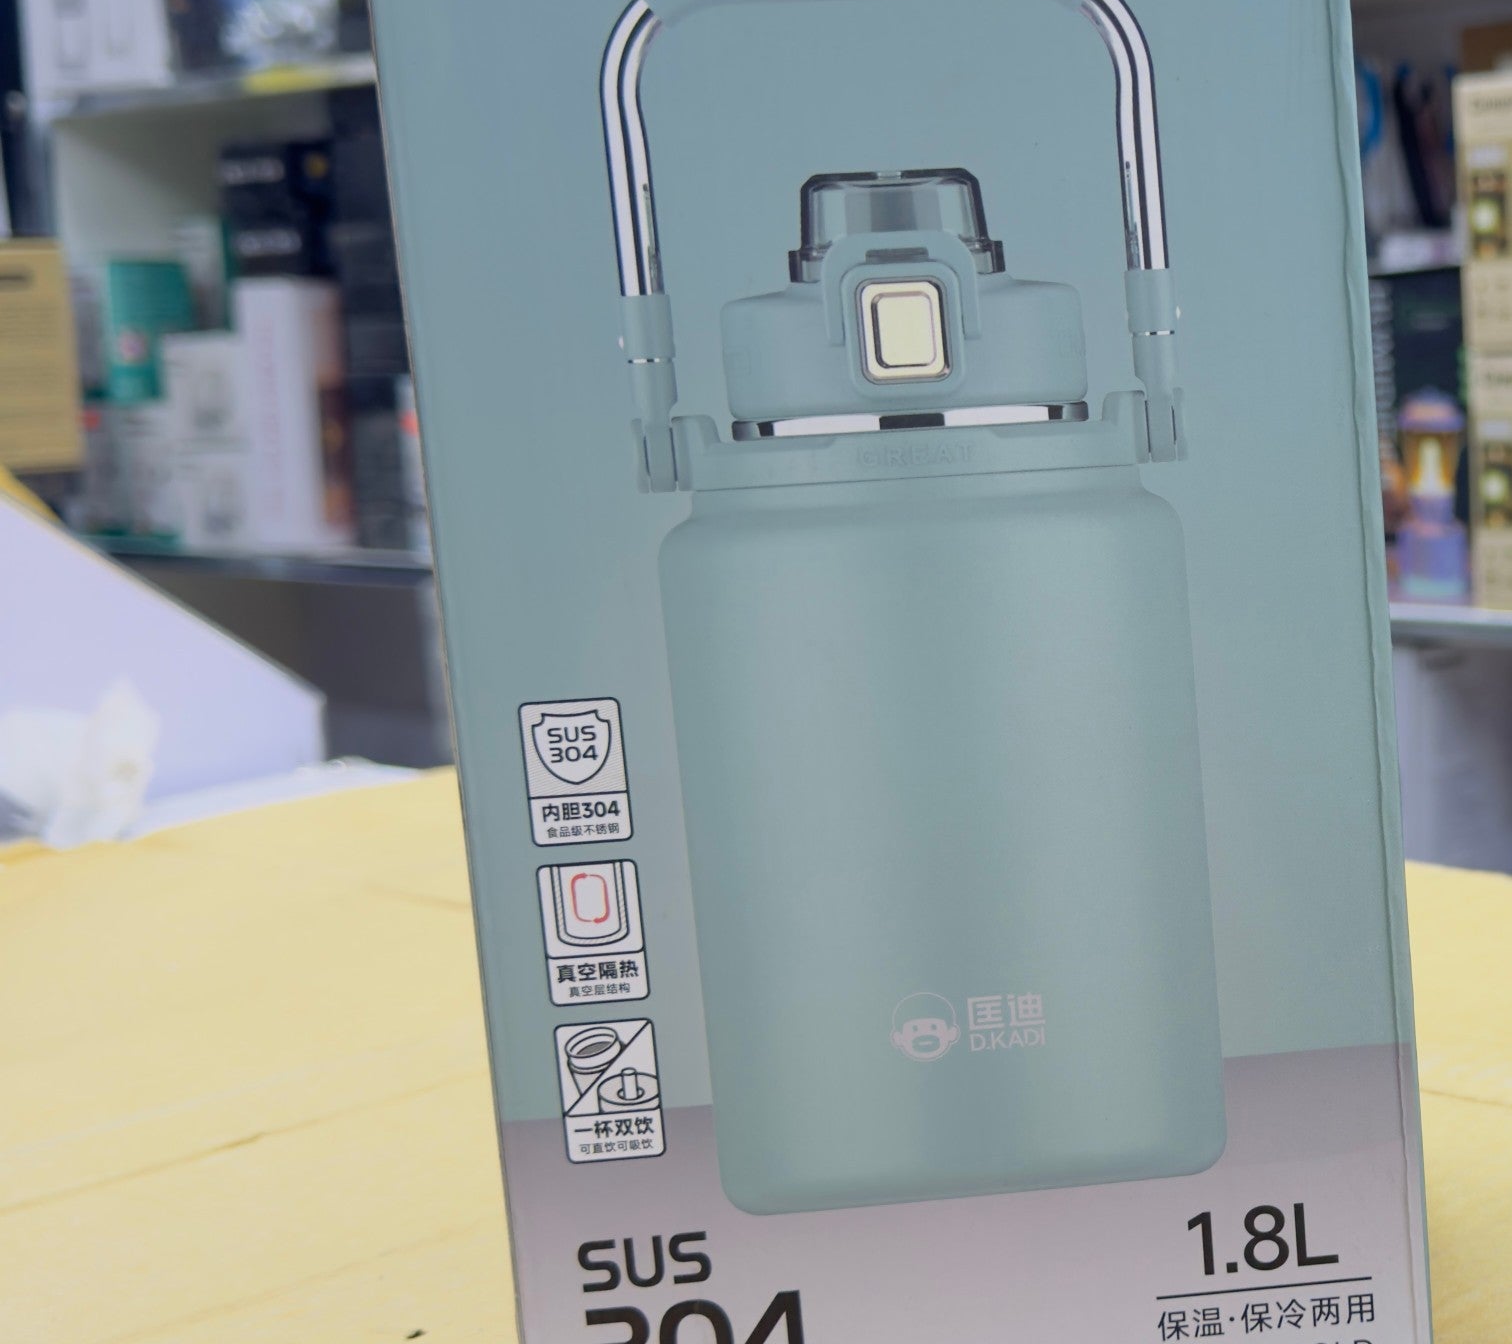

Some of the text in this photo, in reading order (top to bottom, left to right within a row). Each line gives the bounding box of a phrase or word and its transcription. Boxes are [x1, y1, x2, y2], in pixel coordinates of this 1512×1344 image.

[547, 725, 597, 744] SUS
[549, 744, 598, 763] 304
[542, 801, 620, 823] 内胆304
[547, 822, 620, 839] 食品级不锈钢
[556, 960, 639, 983] 真空隔热
[569, 982, 631, 998] 真空层结构
[966, 992, 1046, 1031] 匡迪
[574, 1117, 655, 1139] 一杯双饮
[579, 1138, 654, 1155] 可直饮可吸饮
[1187, 1202, 1340, 1276] 1.8L
[577, 1230, 712, 1293] SUS
[1157, 1293, 1376, 1342] 保温·保冷两用
